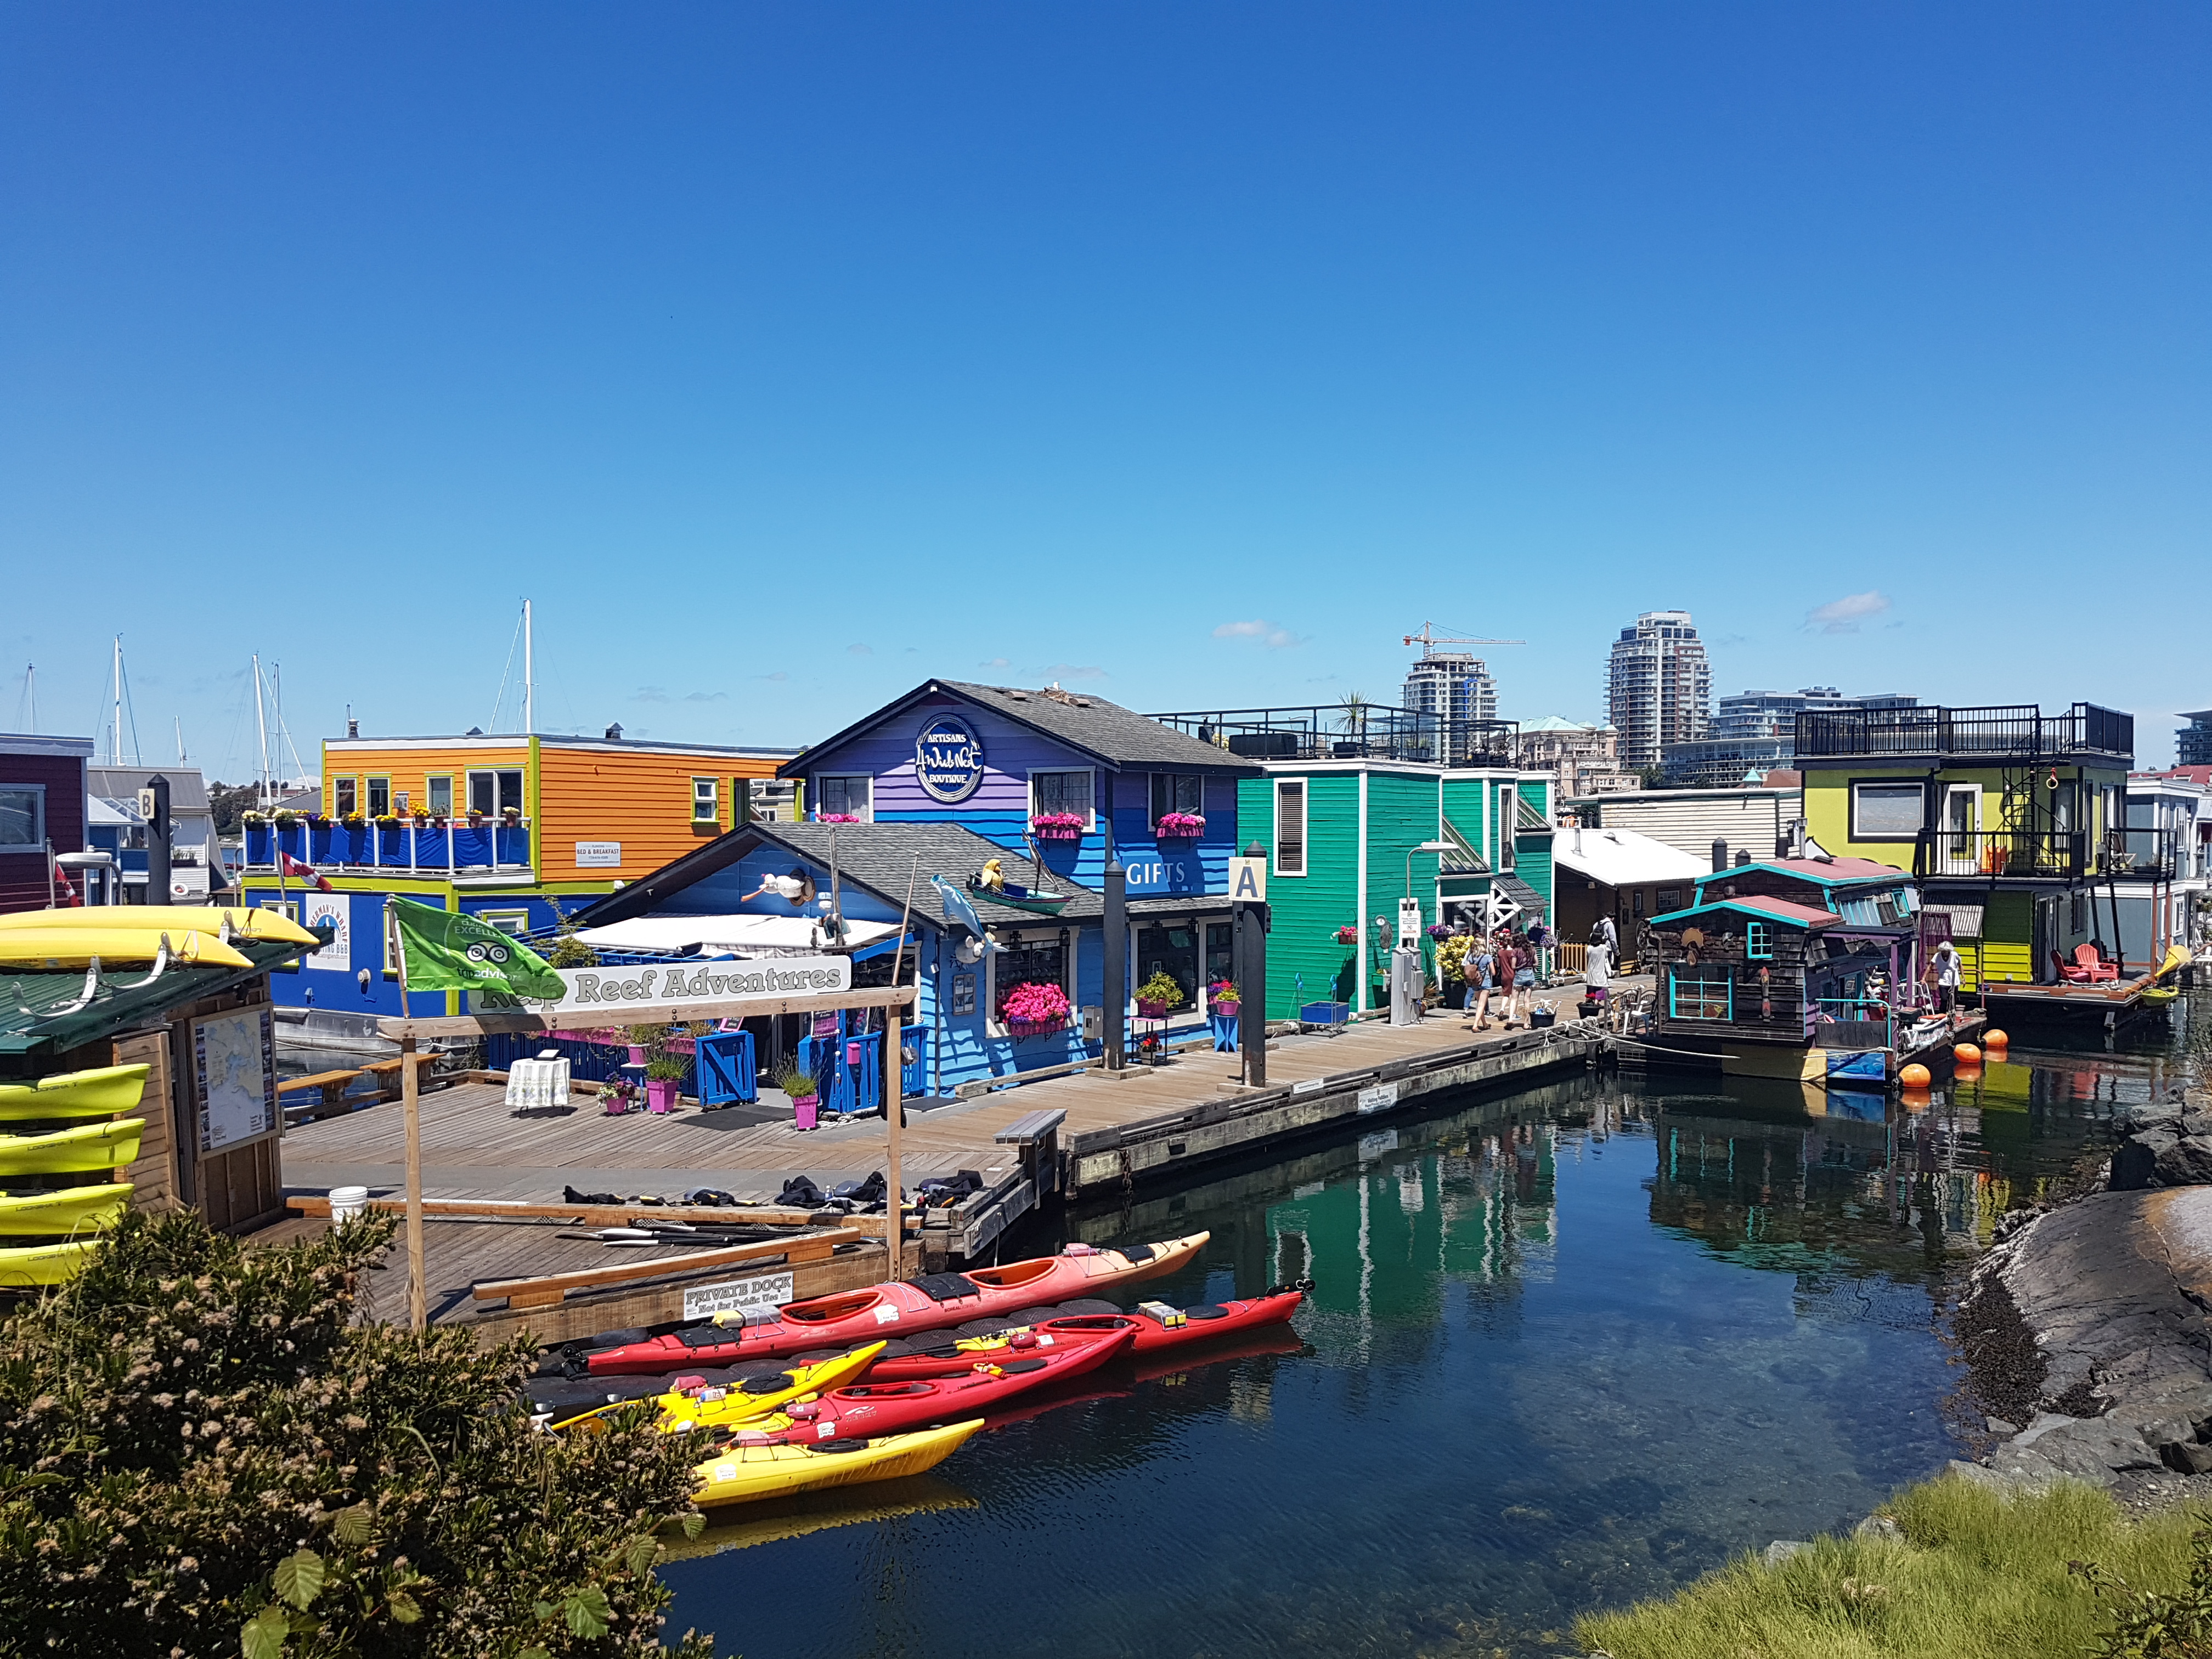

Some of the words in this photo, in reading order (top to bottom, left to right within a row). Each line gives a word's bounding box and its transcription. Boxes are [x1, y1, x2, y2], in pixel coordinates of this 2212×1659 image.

[928, 734, 967, 743] ARTISANS
[929, 774, 968, 783] BOUTIQUE
[143, 794, 151, 816] B
[1126, 862, 1185, 884] GIFTS
[1235, 866, 1259, 898] A
[336, 944, 348, 954] B&B
[457, 967, 519, 981] tripadvisor
[575, 969, 657, 1003] Reef
[661, 967, 842, 998] Adventures
[686, 1283, 749, 1305] PRIVATE
[752, 1276, 792, 1294] DOCK
[698, 1305, 715, 1314] Not
[717, 1302, 731, 1311] for
[733, 1296, 760, 1308] Public
[762, 1293, 779, 1302] Use
